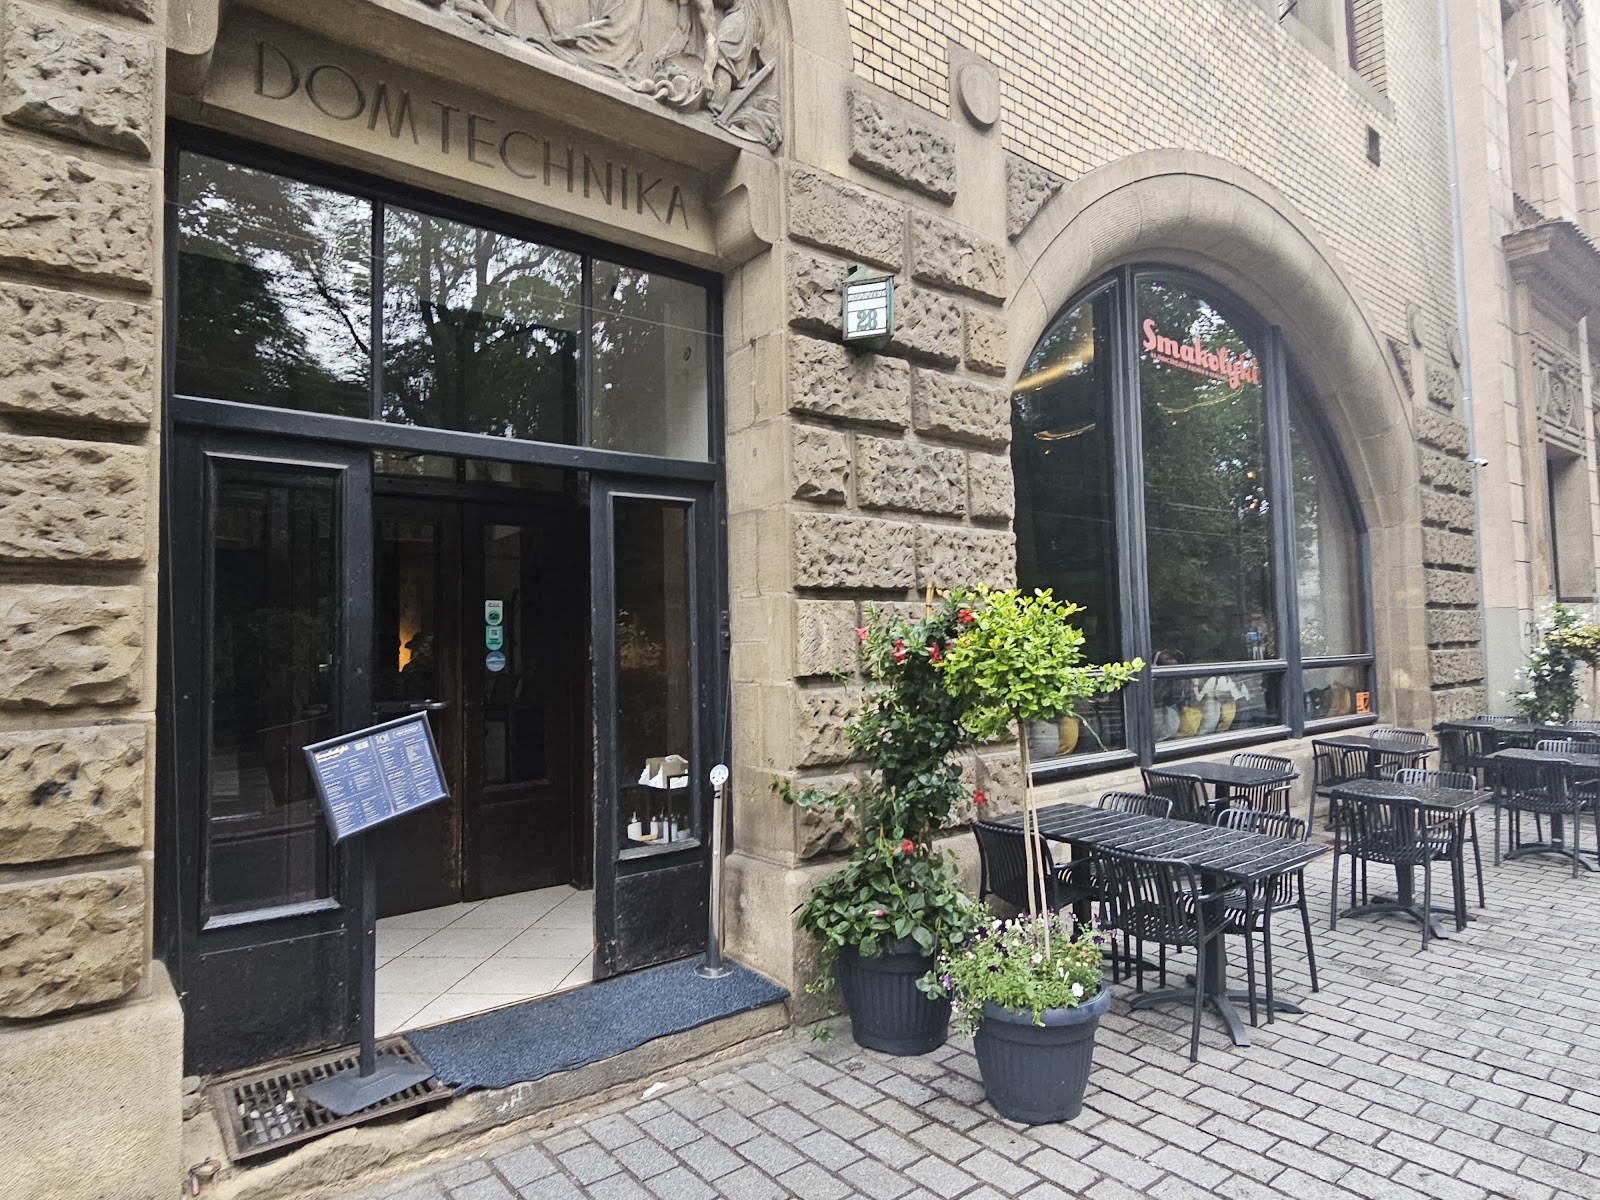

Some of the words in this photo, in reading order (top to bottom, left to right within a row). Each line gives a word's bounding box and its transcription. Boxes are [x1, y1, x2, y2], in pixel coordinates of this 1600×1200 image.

[254, 40, 419, 145] DOM
[431, 99, 690, 230] TECHNIKA
[856, 308, 878, 332] 28
